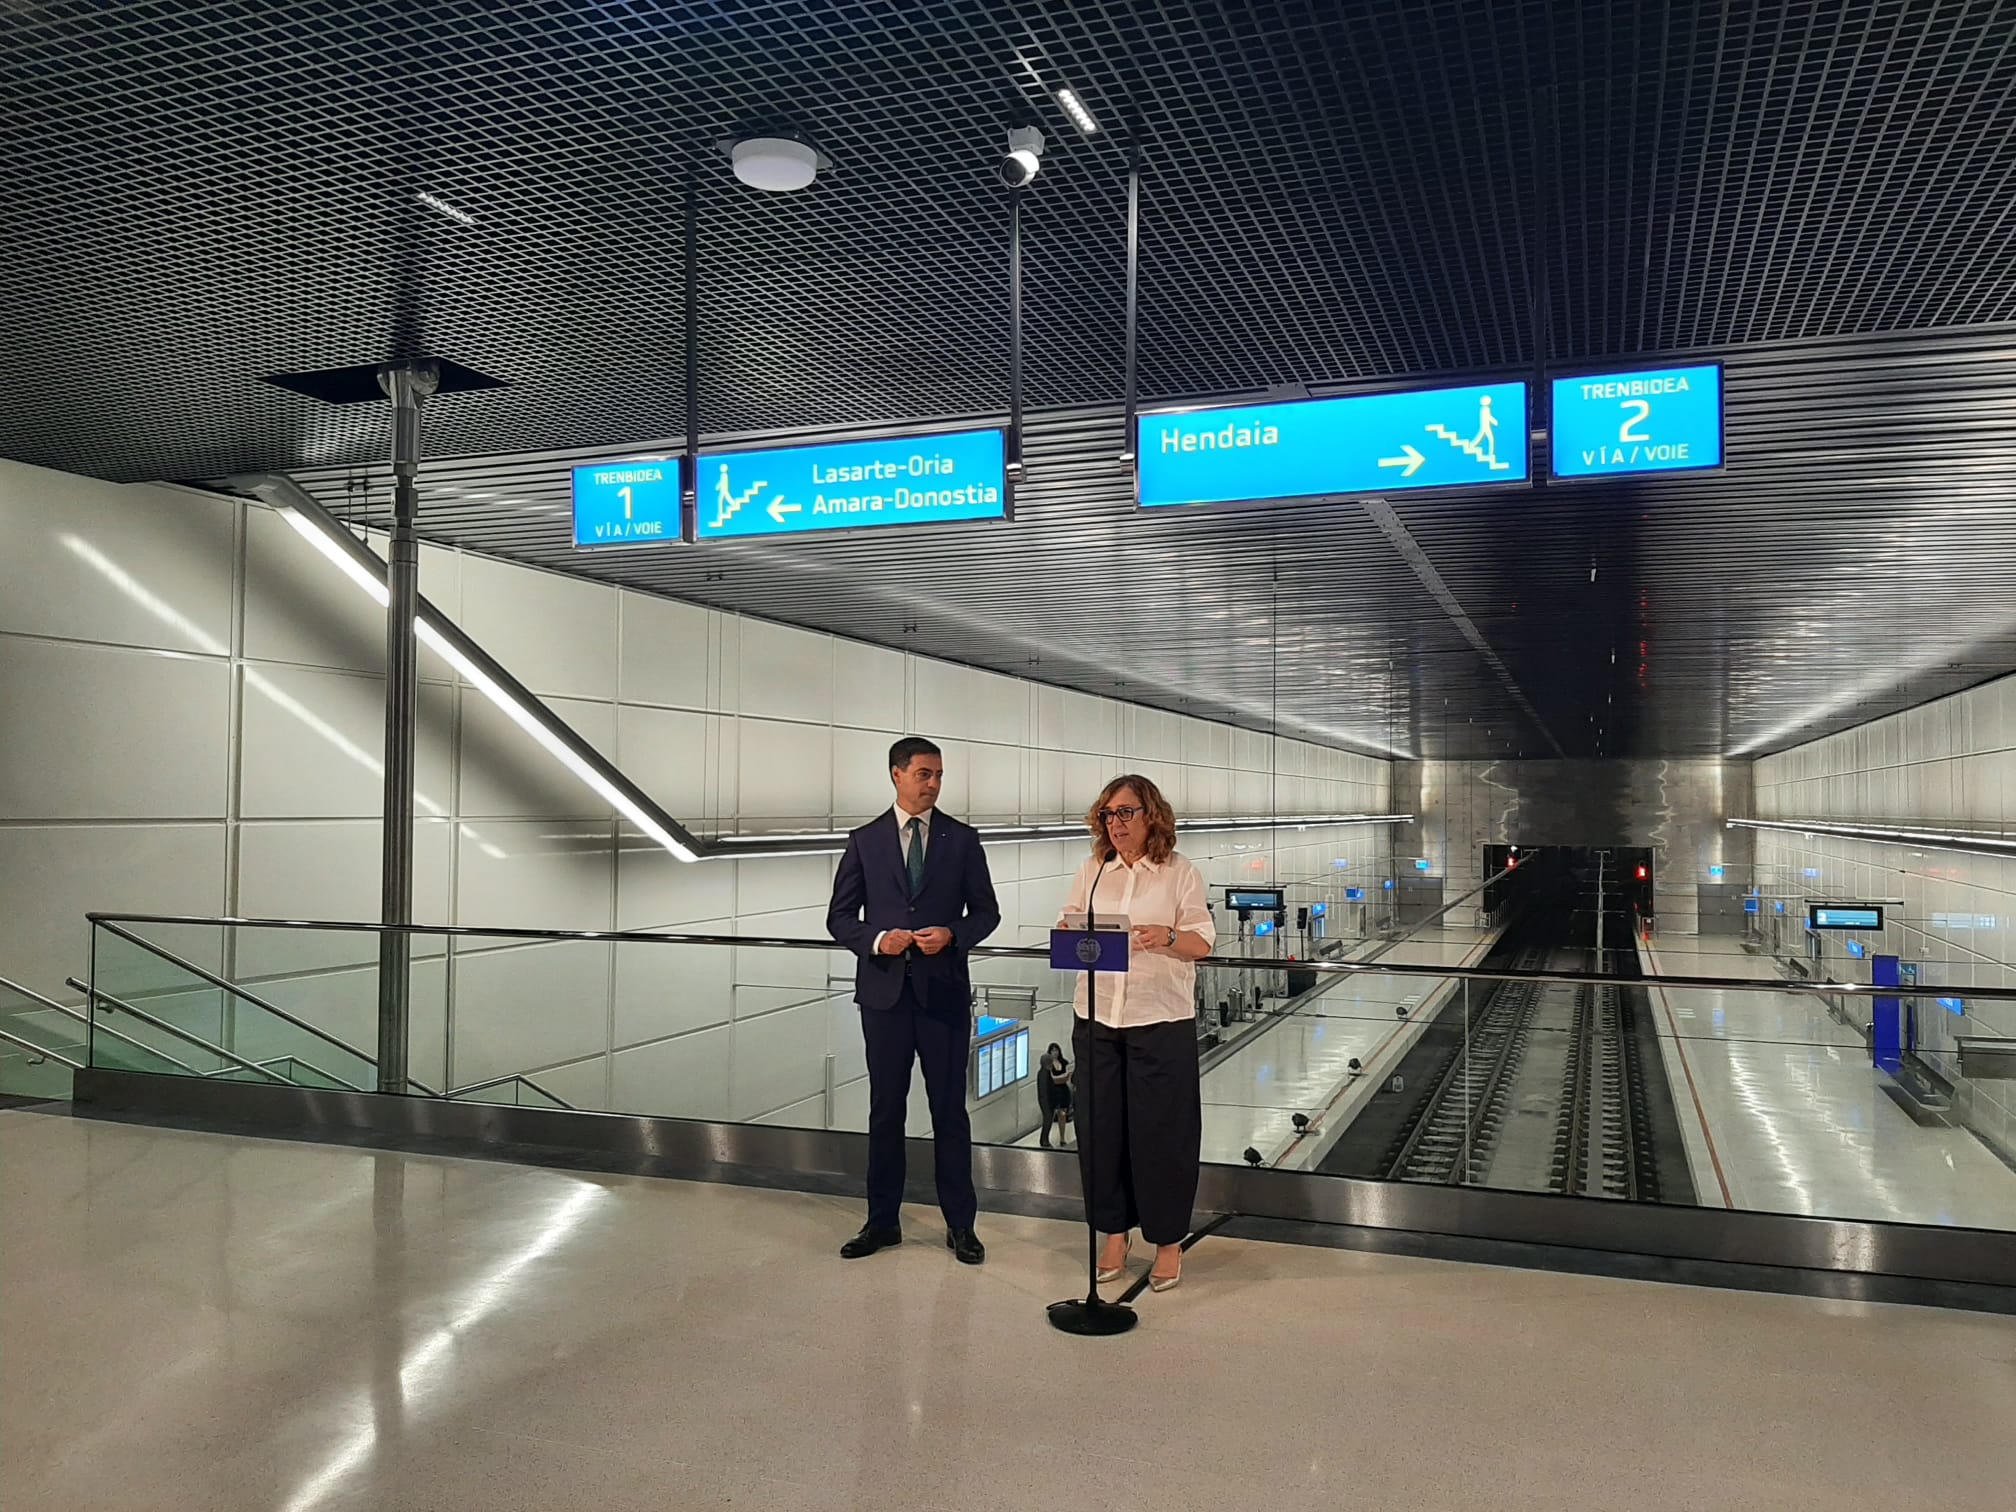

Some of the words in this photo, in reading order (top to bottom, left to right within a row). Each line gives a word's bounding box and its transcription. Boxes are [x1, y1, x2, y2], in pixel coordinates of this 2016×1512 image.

[1580, 377, 1690, 400] TRENBIDEA
[1161, 420, 1279, 454] Hendaia
[1619, 399, 1650, 443] 2
[593, 469, 663, 485] TRENBIDEA
[812, 454, 954, 484] Lasarte-Oria
[617, 486, 632, 520] 1
[812, 483, 998, 515] Amara-Donostia
